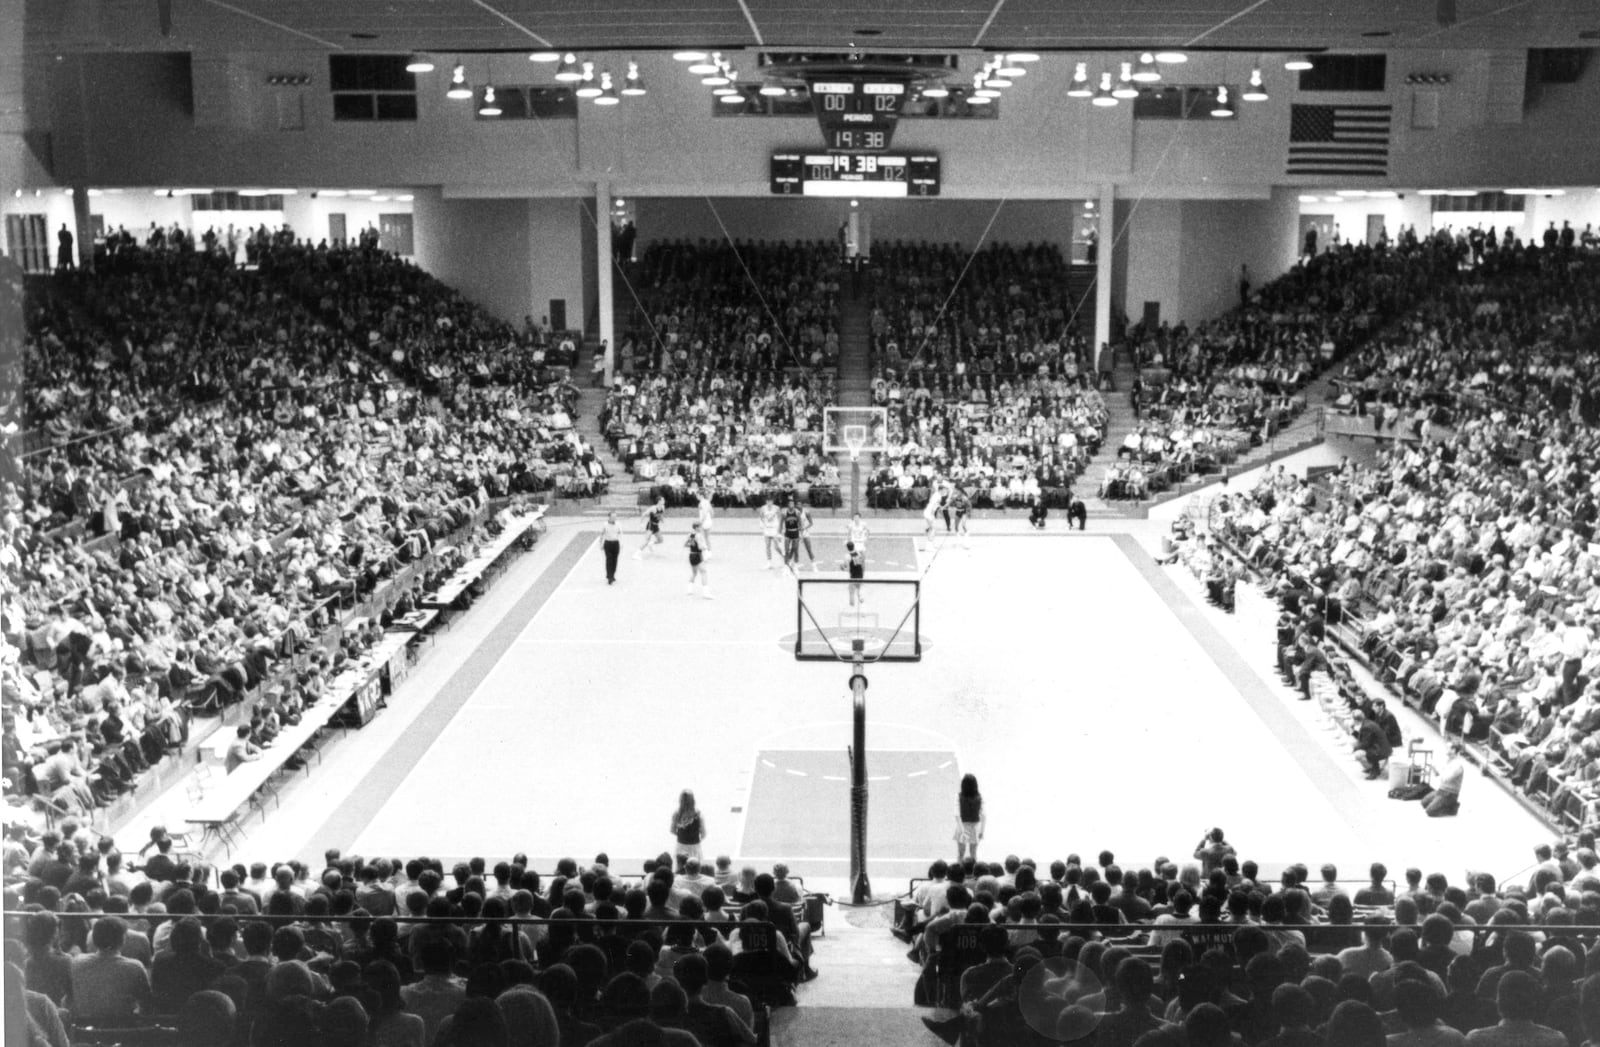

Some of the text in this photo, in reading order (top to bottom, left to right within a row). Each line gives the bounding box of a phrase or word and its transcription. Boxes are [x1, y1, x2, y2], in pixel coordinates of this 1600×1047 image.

[875, 95, 896, 111] 02
[843, 114, 873, 122] PERIOD
[884, 167, 904, 180] 02
[749, 934, 767, 947] 109
[957, 935, 977, 949] 108
